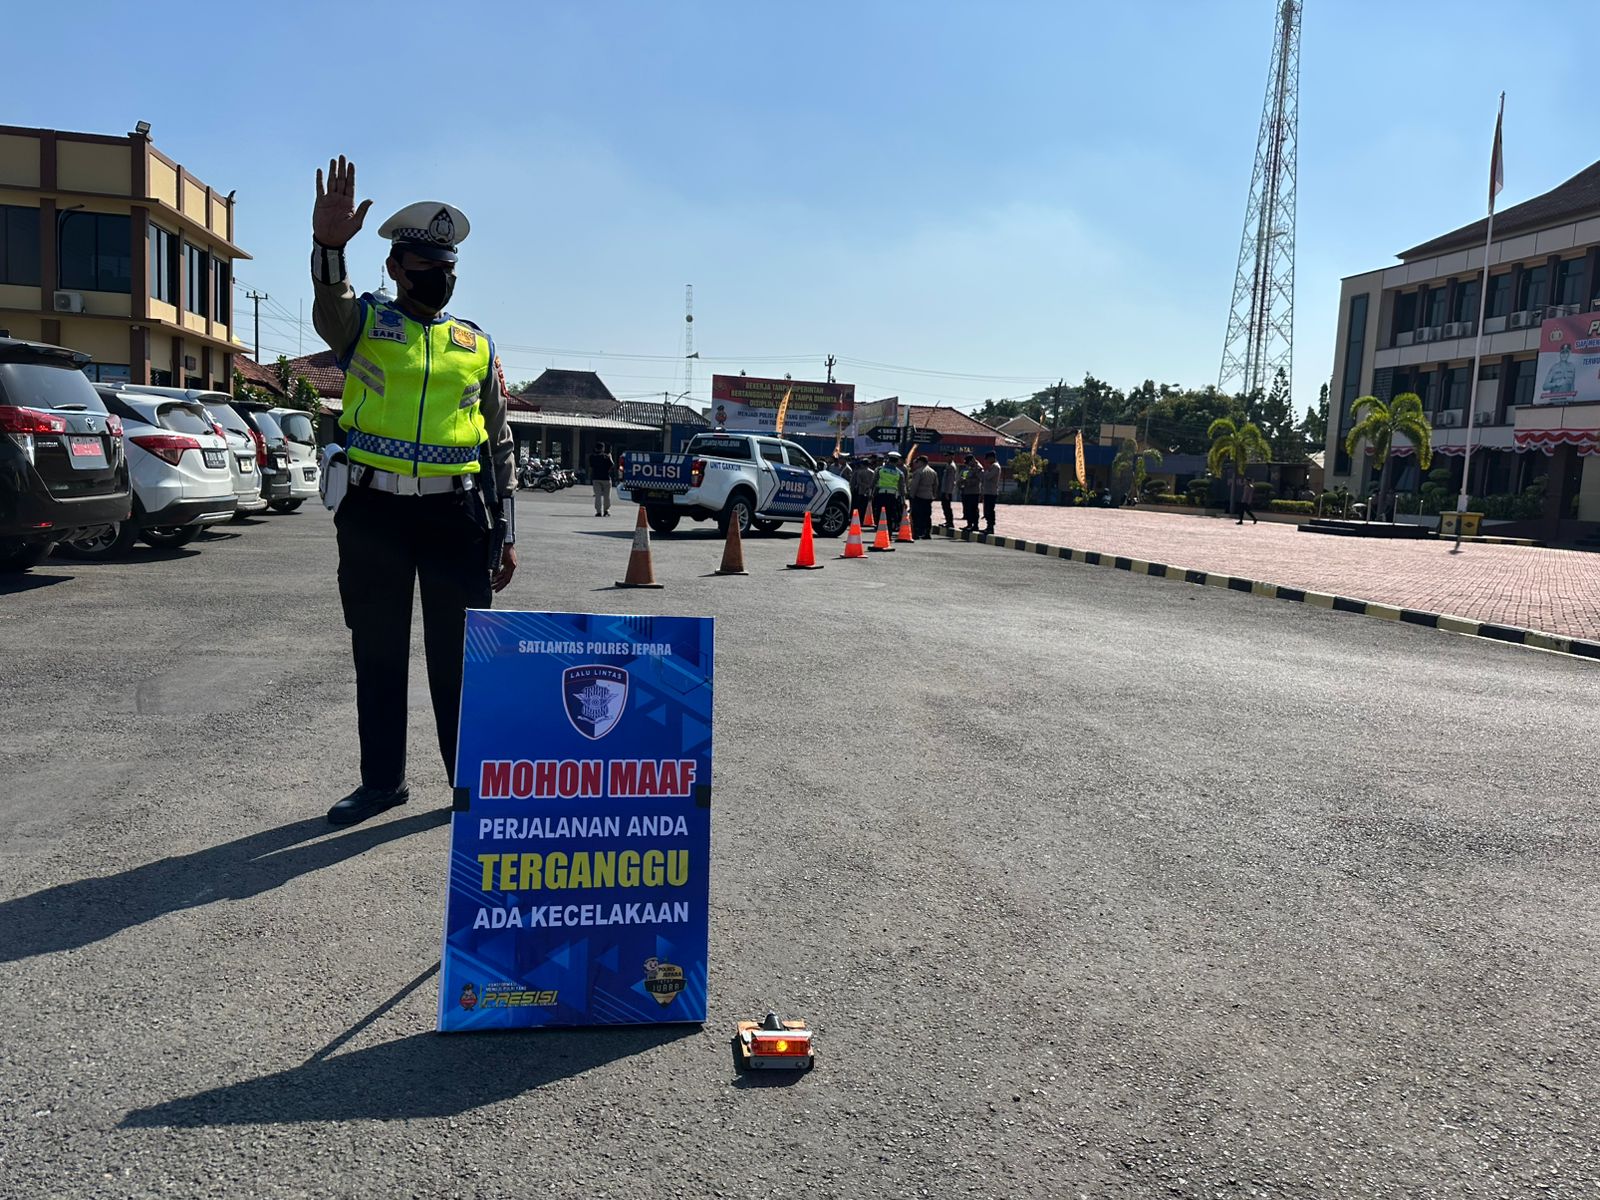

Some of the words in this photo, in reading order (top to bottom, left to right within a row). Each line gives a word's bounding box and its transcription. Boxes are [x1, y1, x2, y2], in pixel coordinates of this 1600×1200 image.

[632, 464, 681, 479] POLISI
[710, 461, 721, 469] UNIT
[780, 480, 806, 493] POLISI
[518, 640, 584, 655] SATLANTAS
[586, 641, 629, 656] POLRES
[631, 642, 672, 657] JEPARA
[570, 670, 591, 679] LALU
[594, 669, 622, 680] LINTAS
[479, 759, 603, 799] MOHON
[607, 759, 697, 798] MAAF
[479, 816, 620, 840] PERJALANAN
[626, 815, 689, 837] ANDA
[477, 849, 689, 891] TERGANGGU
[472, 906, 523, 930] ADA
[530, 901, 689, 928] KECELAKAAN
[482, 990, 559, 1007] PRESISI
